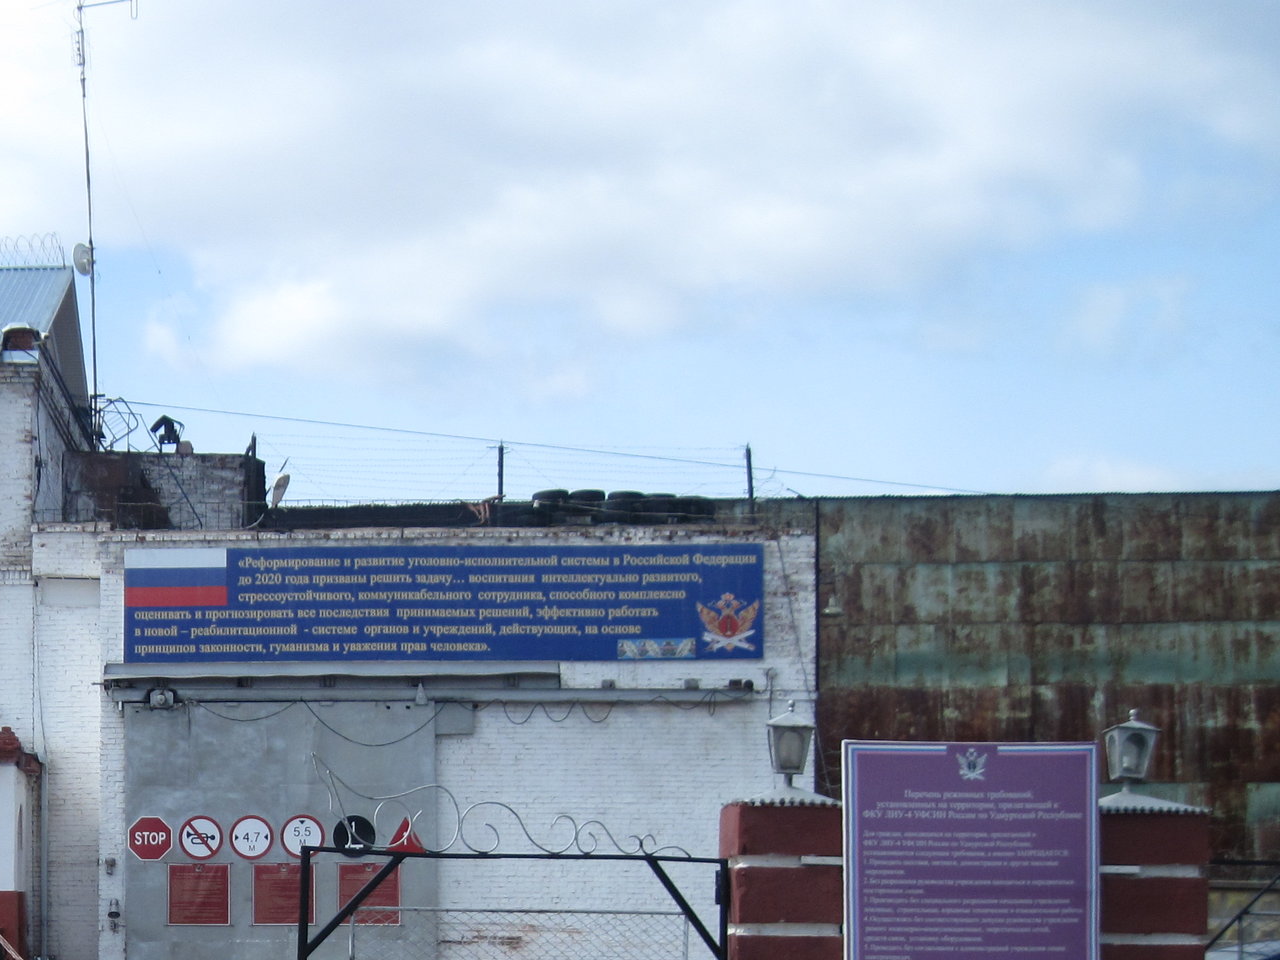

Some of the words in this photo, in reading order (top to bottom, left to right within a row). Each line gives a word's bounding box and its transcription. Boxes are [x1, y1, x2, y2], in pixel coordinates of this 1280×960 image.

[238, 556, 341, 571] «Реформирование
[343, 558, 351, 567] и
[353, 557, 405, 570] развитие
[407, 555, 558, 569] уголовно-исполнительной
[560, 557, 610, 567] системы
[613, 557, 620, 566] в
[623, 554, 690, 566] Российской
[692, 553, 757, 568] Федерации
[237, 575, 253, 586] до
[254, 573, 283, 584] 2020
[285, 575, 310, 585] года
[312, 575, 367, 586] призваны
[369, 575, 413, 585] решить
[468, 575, 536, 584] воспитания
[541, 574, 640, 585] интеллектуально
[642, 573, 703, 584] развитого,
[237, 589, 355, 605] стрессоустойчивого,
[358, 588, 472, 603] коммуникабельного
[477, 591, 547, 604] сотрудника,
[549, 588, 616, 600] способного
[618, 590, 686, 600] комплексно
[134, 610, 192, 621] оценивать
[194, 610, 203, 620] и
[205, 609, 295, 622] прогнозировать
[297, 609, 317, 618] все
[318, 608, 390, 619] последствия
[396, 608, 476, 620] принимаемых
[478, 606, 533, 620] решений,
[536, 605, 606, 620] эффективно
[608, 605, 659, 620] работать
[134, 627, 142, 637] в
[144, 625, 178, 637] новой
[190, 623, 298, 639] реабилитационной
[311, 625, 358, 635] системе
[363, 625, 410, 637] органов
[412, 625, 420, 634] и
[423, 623, 497, 637] учреждений,
[498, 623, 582, 637] действующих,
[584, 625, 599, 634] на
[601, 625, 641, 634] основе
[134, 644, 197, 657] принципов
[199, 643, 267, 654] законности,
[269, 642, 330, 655] гуманизма
[332, 643, 340, 652] и
[342, 642, 398, 655] уважения
[400, 642, 427, 654] прав
[430, 642, 491, 652] человека».
[134, 831, 166, 846] STOP
[242, 831, 261, 843] 4.7
[293, 826, 312, 837] 5.5
